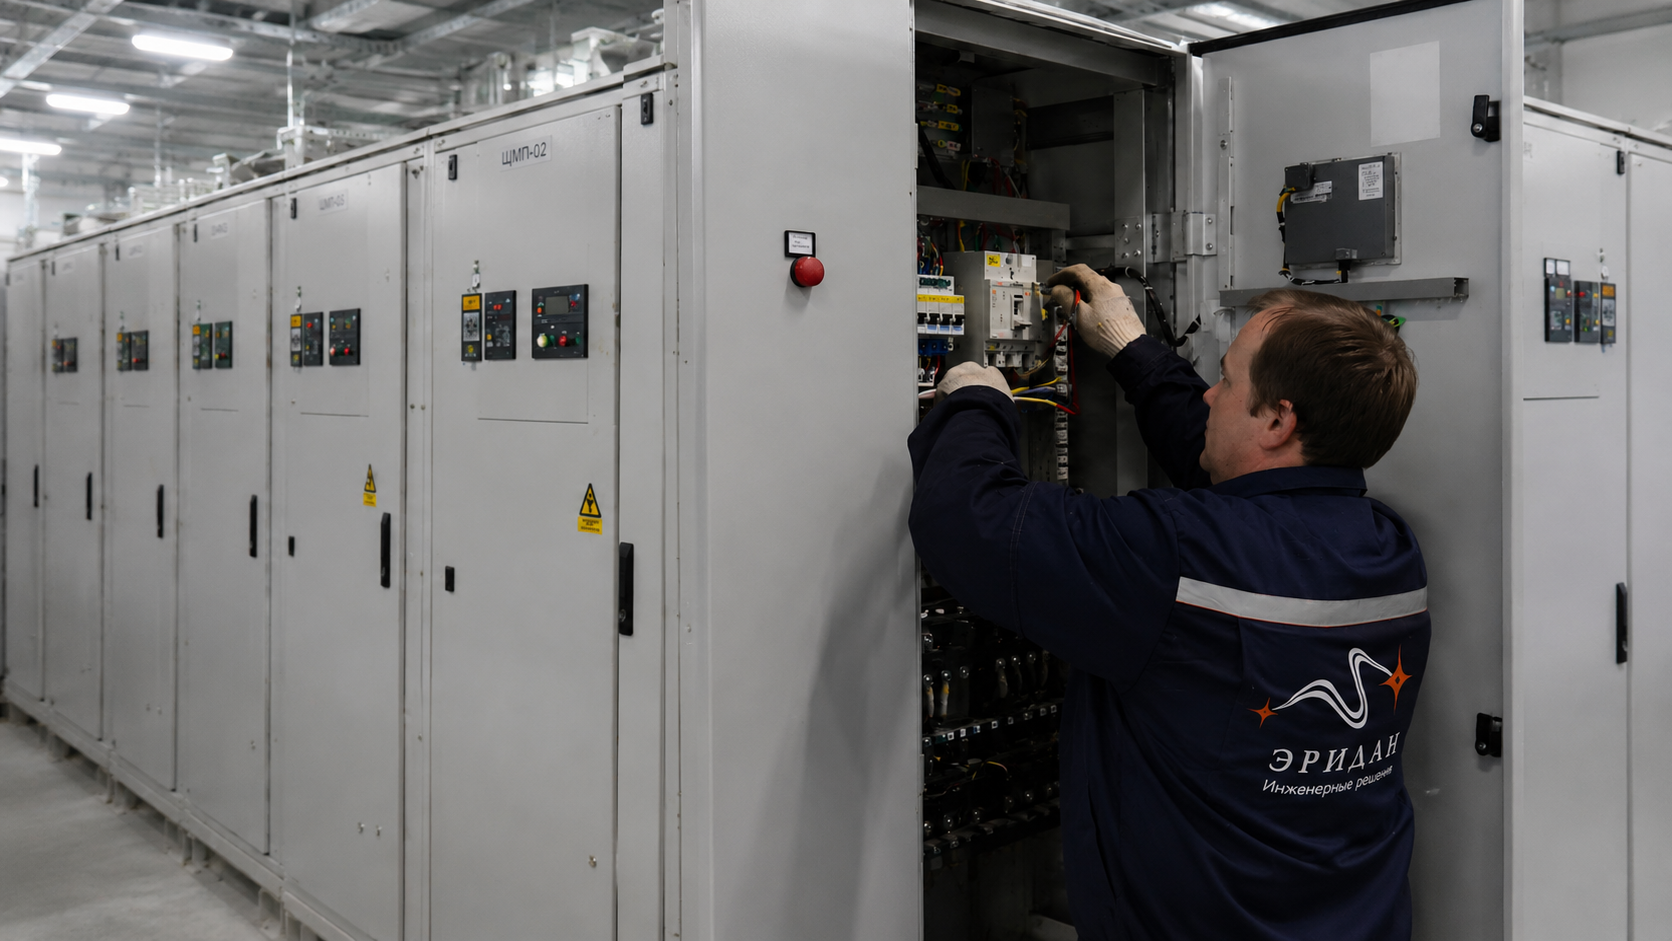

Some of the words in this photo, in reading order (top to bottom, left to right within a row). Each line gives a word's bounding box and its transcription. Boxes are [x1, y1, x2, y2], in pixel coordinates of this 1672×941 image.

[502, 142, 547, 167] ЩМП-02
[1268, 732, 1400, 773] ЭРИДАН
[1262, 779, 1353, 798] Инженерные
